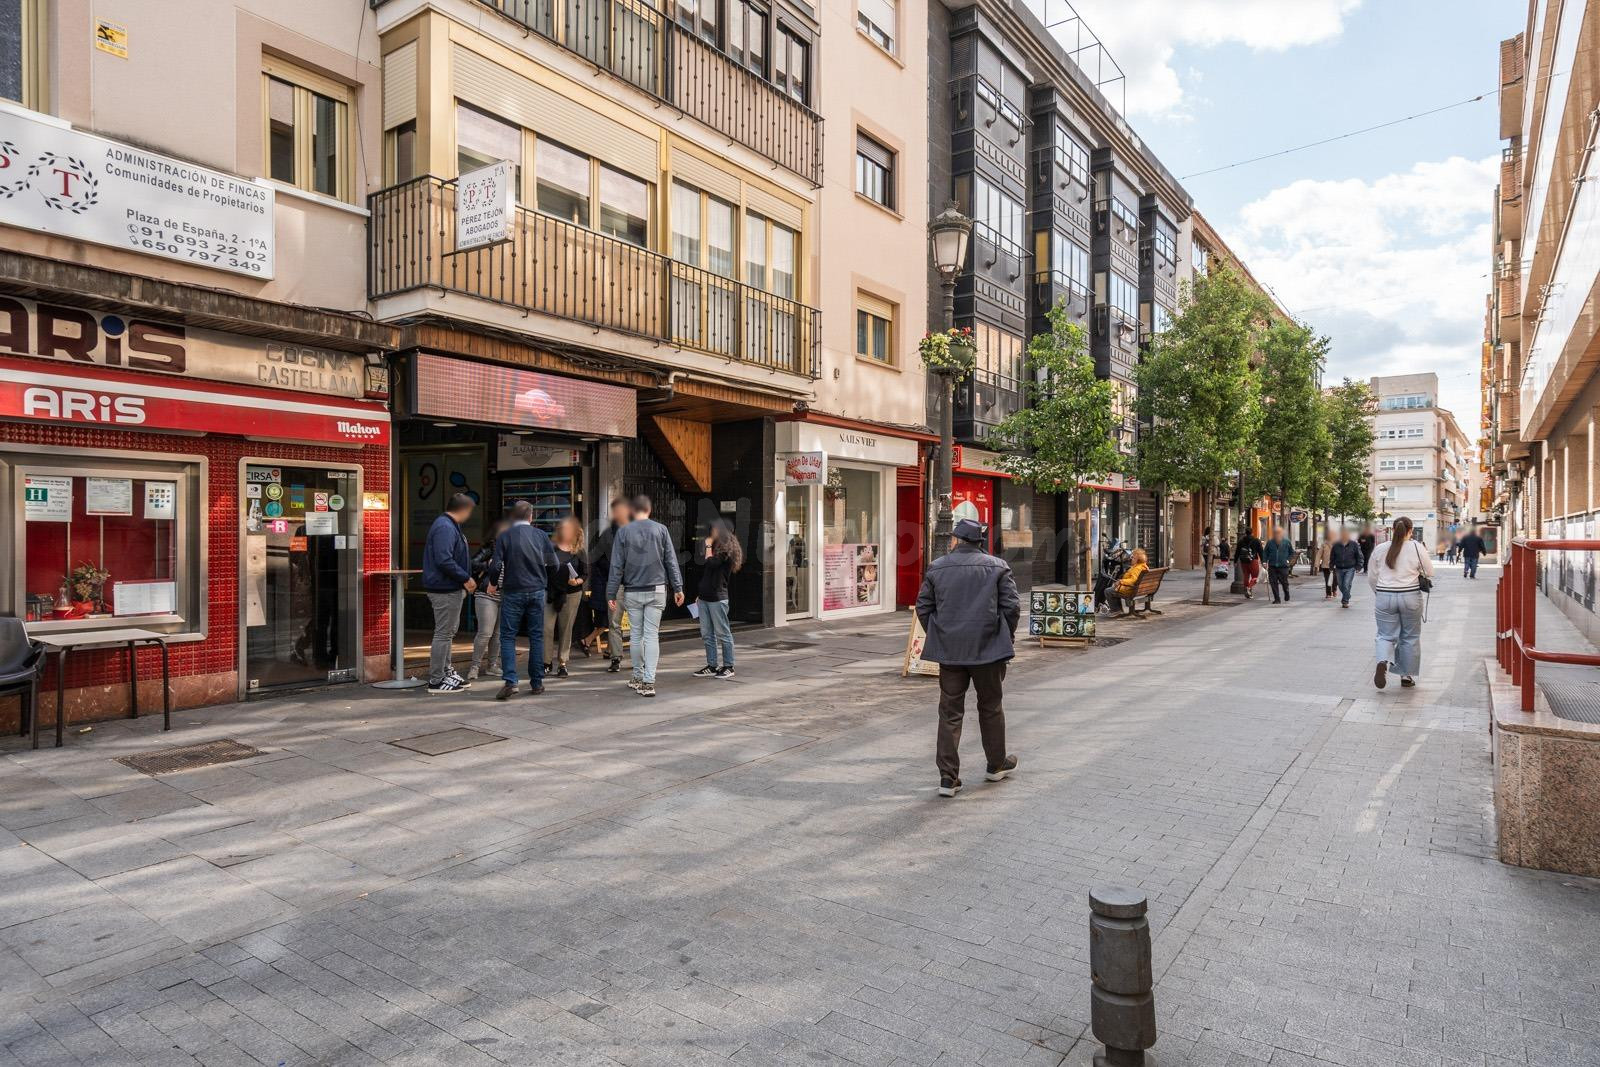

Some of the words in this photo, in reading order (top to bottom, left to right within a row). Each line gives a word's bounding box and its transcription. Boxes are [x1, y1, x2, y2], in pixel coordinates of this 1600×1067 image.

[52, 168, 80, 198] T
[105, 163, 184, 194] Comunidades
[187, 186, 200, 198] de
[203, 189, 265, 214] Propietarios
[106, 148, 207, 184] ADMINISTRACIÓN
[211, 177, 225, 190] DE
[228, 183, 266, 201] FINCAS
[126, 208, 160, 226] Plaza
[164, 219, 178, 230] de
[182, 222, 228, 243] España,
[231, 234, 238, 244] 2
[465, 220, 499, 236] ABOGADOS
[141, 226, 163, 239] 91
[173, 234, 209, 249] 693
[216, 244, 239, 256] 22
[245, 250, 267, 262] 02
[141, 239, 179, 254] 650
[186, 248, 221, 263] 797
[228, 258, 261, 272] 349
[266, 343, 352, 373] COCINA
[257, 364, 360, 398] CASTELLANA
[336, 421, 381, 435] Mahou
[839, 433, 860, 445] NAILS
[861, 436, 877, 447] VIET
